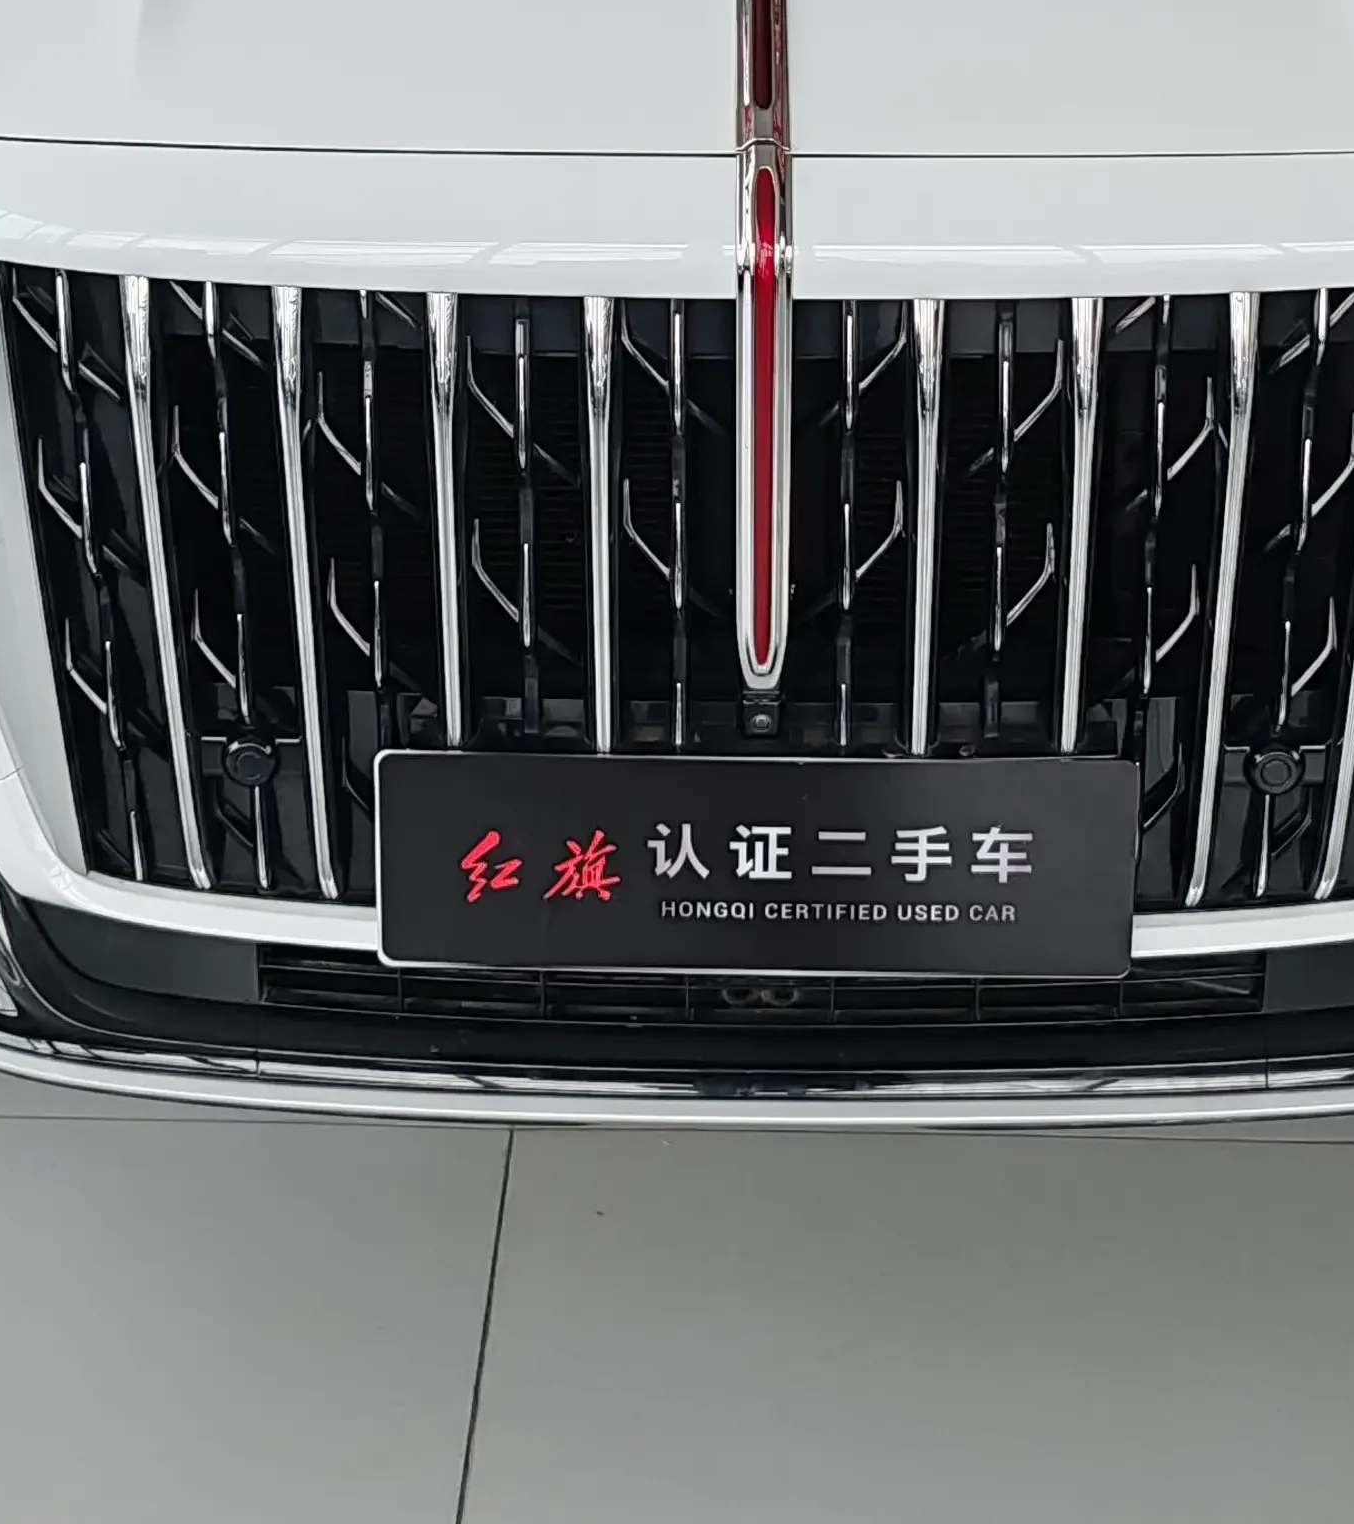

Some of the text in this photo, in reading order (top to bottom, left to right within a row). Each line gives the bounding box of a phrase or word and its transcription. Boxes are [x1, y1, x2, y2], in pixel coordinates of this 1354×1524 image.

[460, 822, 1034, 903] 红旗 认证二手车
[661, 900, 1016, 922] HONGQI CERTIFIED USED CAR
